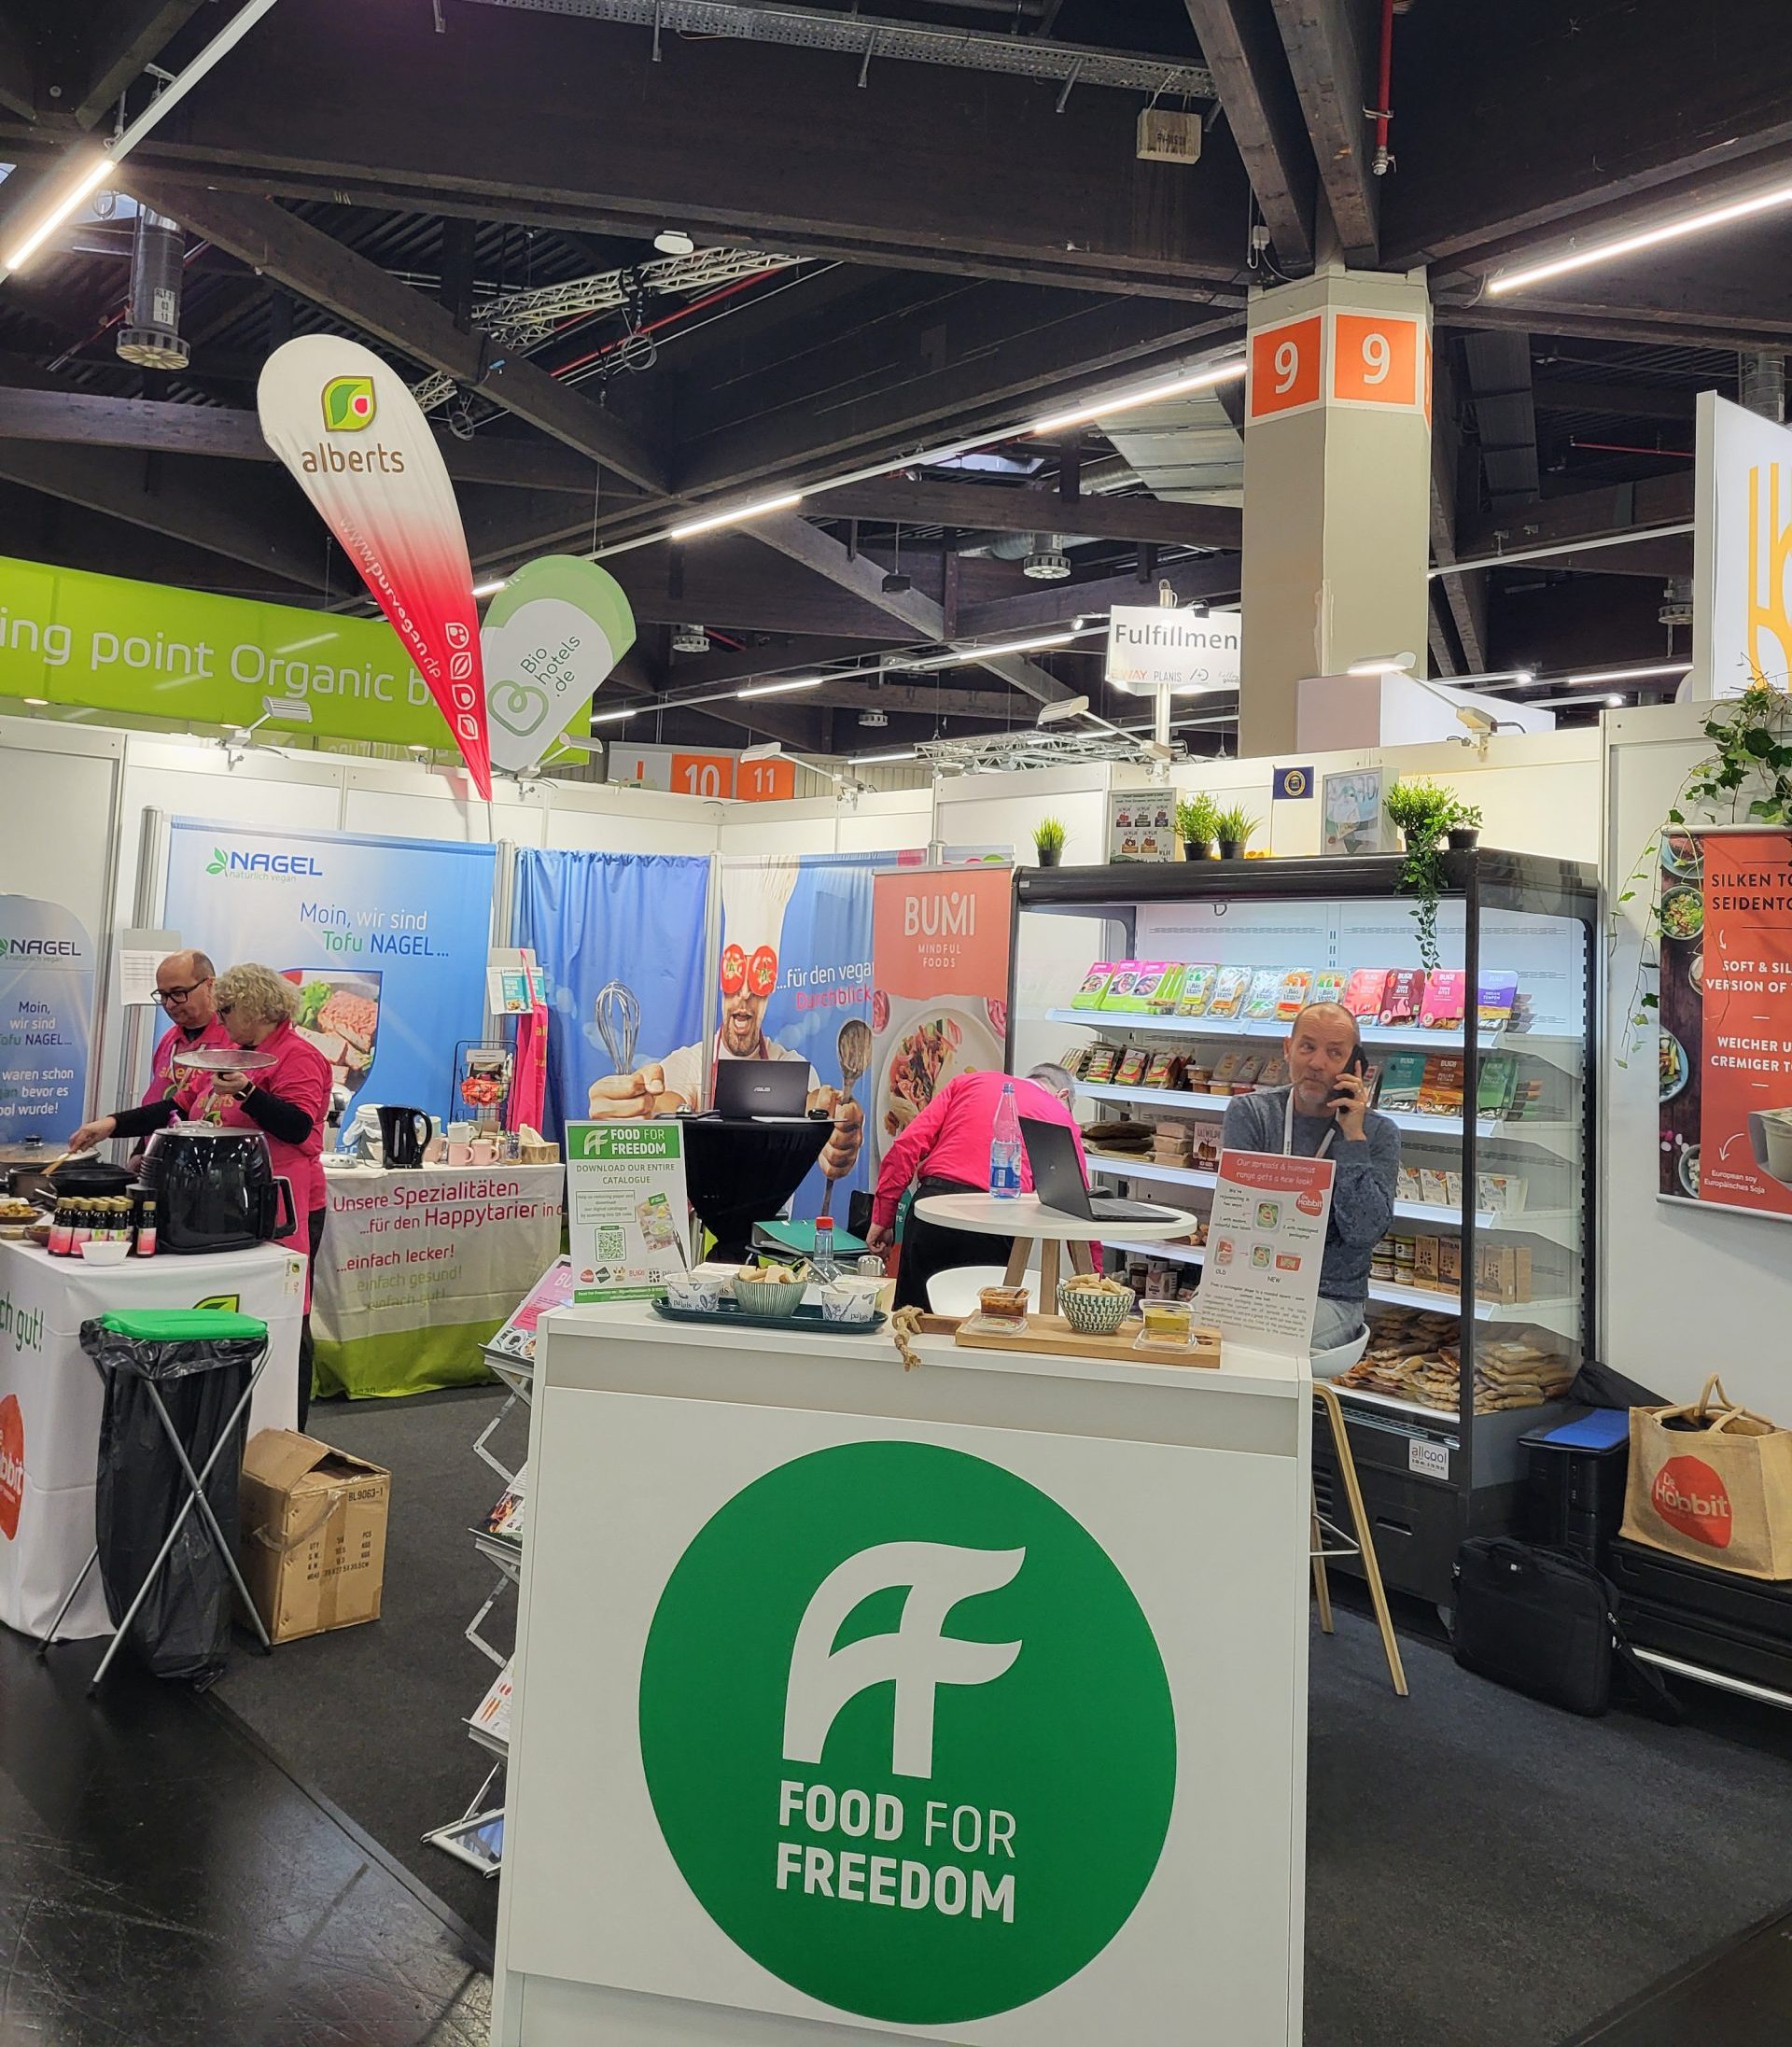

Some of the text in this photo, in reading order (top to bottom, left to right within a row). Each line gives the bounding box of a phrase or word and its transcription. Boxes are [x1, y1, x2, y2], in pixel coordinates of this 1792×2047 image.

[1275, 342, 1299, 394] 9
[1362, 333, 1391, 385] 9
[301, 442, 405, 474] alberts
[1115, 624, 1240, 651] Fulfillmen
[91, 632, 214, 678] point
[231, 644, 394, 698] Organic
[521, 646, 548, 674] Bio
[534, 635, 581, 685] hotels
[555, 670, 576, 698] .de
[685, 764, 721, 796] 10
[753, 767, 776, 793] 11
[231, 851, 324, 876] NAGEL
[1711, 873, 1771, 888] SILKEN
[300, 902, 428, 932] Moin, wir sind
[903, 891, 976, 936] BUMI
[10, 939, 82, 957] NAGEL
[322, 930, 363, 953] Tofu
[917, 944, 962, 955] MINDFUL
[922, 957, 957, 968] FOODS
[1722, 960, 1755, 974] SOFT
[1758, 961, 1768, 974] &
[810, 965, 835, 984] den
[1705, 978, 1787, 993] VERSION OF
[796, 984, 873, 1012] Durchblick
[19, 1001, 51, 1016] Moin,
[9, 1017, 56, 1030] wir sind
[1717, 1035, 1778, 1052] WEICHER
[1711, 1055, 1792, 1073] CREMIGER T
[3, 1068, 75, 1081] waren schon
[21, 1087, 54, 1099] bevor
[56, 1086, 69, 1098] es
[18, 1102, 59, 1116] wurde!
[610, 1129, 665, 1141] FOOD FOR
[611, 1143, 666, 1155] FREEDOM
[576, 1164, 625, 1172] DOWNLOAD
[1236, 1158, 1250, 1167] Our
[602, 1176, 651, 1185] CATALOGUE
[1236, 1171, 1255, 1180] range
[1257, 1173, 1271, 1183] gets
[1711, 1170, 1757, 1184] European soy
[333, 1179, 520, 1213] Unsere Spezialitäten
[1749, 1184, 1766, 1195] Soja
[1298, 1199, 1323, 1208] Hobbit
[394, 1216, 420, 1231] den
[425, 1200, 539, 1229] Happytarier
[543, 1202, 554, 1217] in
[406, 1243, 455, 1263] lecker!
[409, 1265, 462, 1289] gesund!
[16, 1306, 44, 1353] gut!
[1411, 1445, 1447, 1465] allcool
[1656, 1479, 1729, 1518] Hobbit
[778, 1780, 1016, 1858] FOOD FOR
[776, 1842, 1015, 1924] FREEDOM
